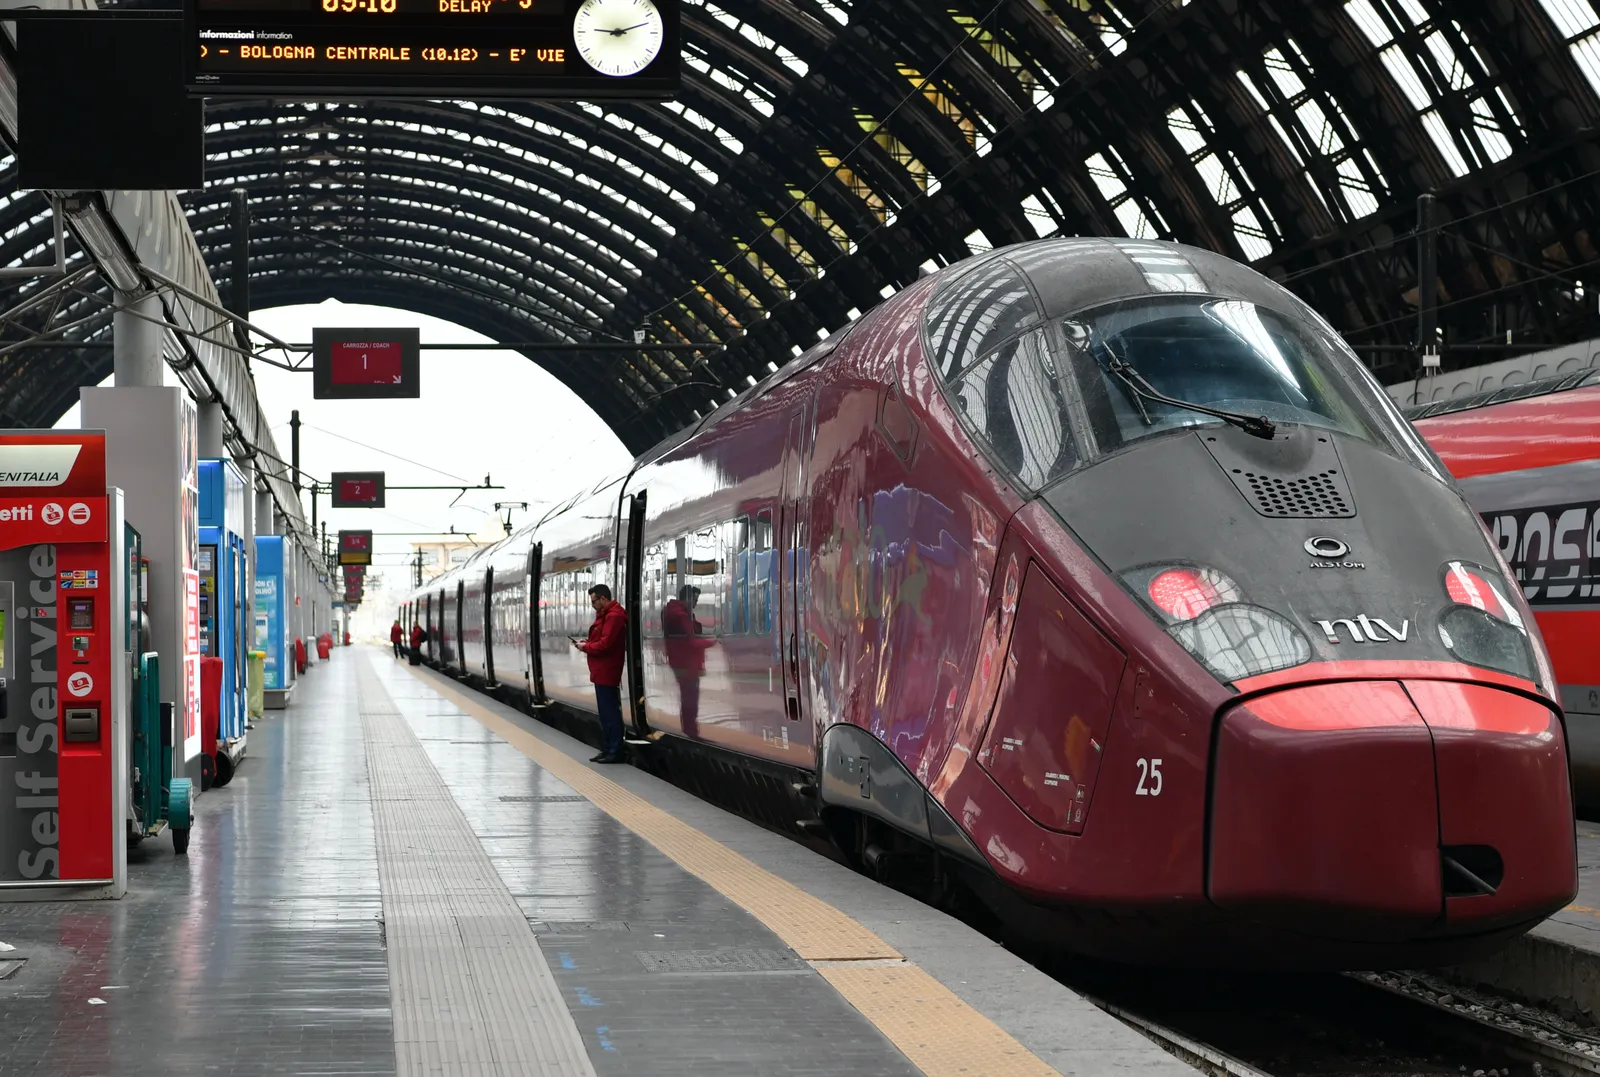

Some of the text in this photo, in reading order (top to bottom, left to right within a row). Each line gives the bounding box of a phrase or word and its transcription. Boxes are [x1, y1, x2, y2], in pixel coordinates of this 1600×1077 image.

[439, 0, 492, 13] DELAY
[199, 30, 293, 40] informazioni information
[240, 45, 316, 59] BOLOGNA
[326, 46, 411, 60] CENTRALE
[421, 48, 479, 61] (10.12)
[537, 49, 565, 62] VIE
[361, 353, 367, 370] 1
[355, 485, 361, 495] 2
[0, 504, 33, 521] etti
[1309, 561, 1366, 569] ALSTOM
[1312, 613, 1409, 644] ntv
[15, 544, 60, 879] Self Service
[1135, 758, 1163, 796] 25
